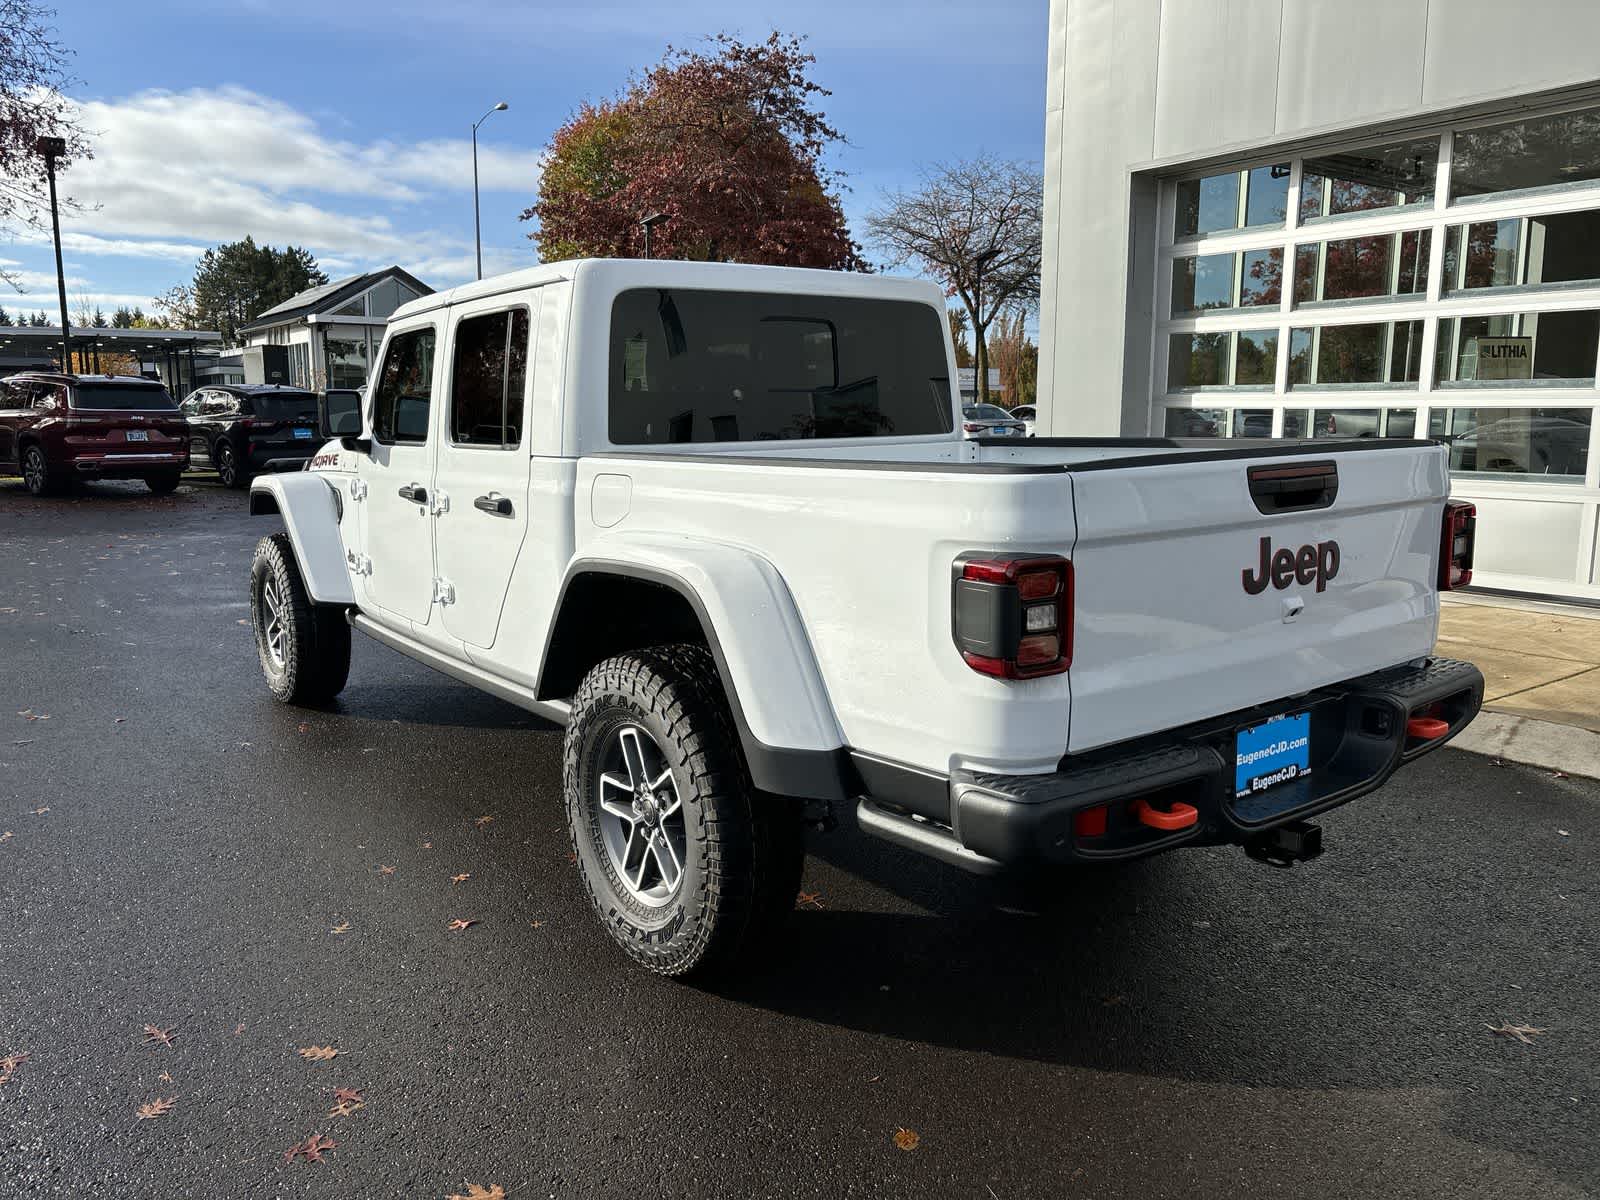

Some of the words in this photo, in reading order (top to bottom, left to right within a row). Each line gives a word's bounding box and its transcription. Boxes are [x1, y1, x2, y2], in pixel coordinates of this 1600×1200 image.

[1491, 345, 1528, 358] LITHIA
[312, 454, 339, 468] OJAVE
[1242, 536, 1341, 596] Jeep
[1236, 737, 1308, 766] EugeneCJD.com
[1253, 765, 1296, 790] EugeneCJD
